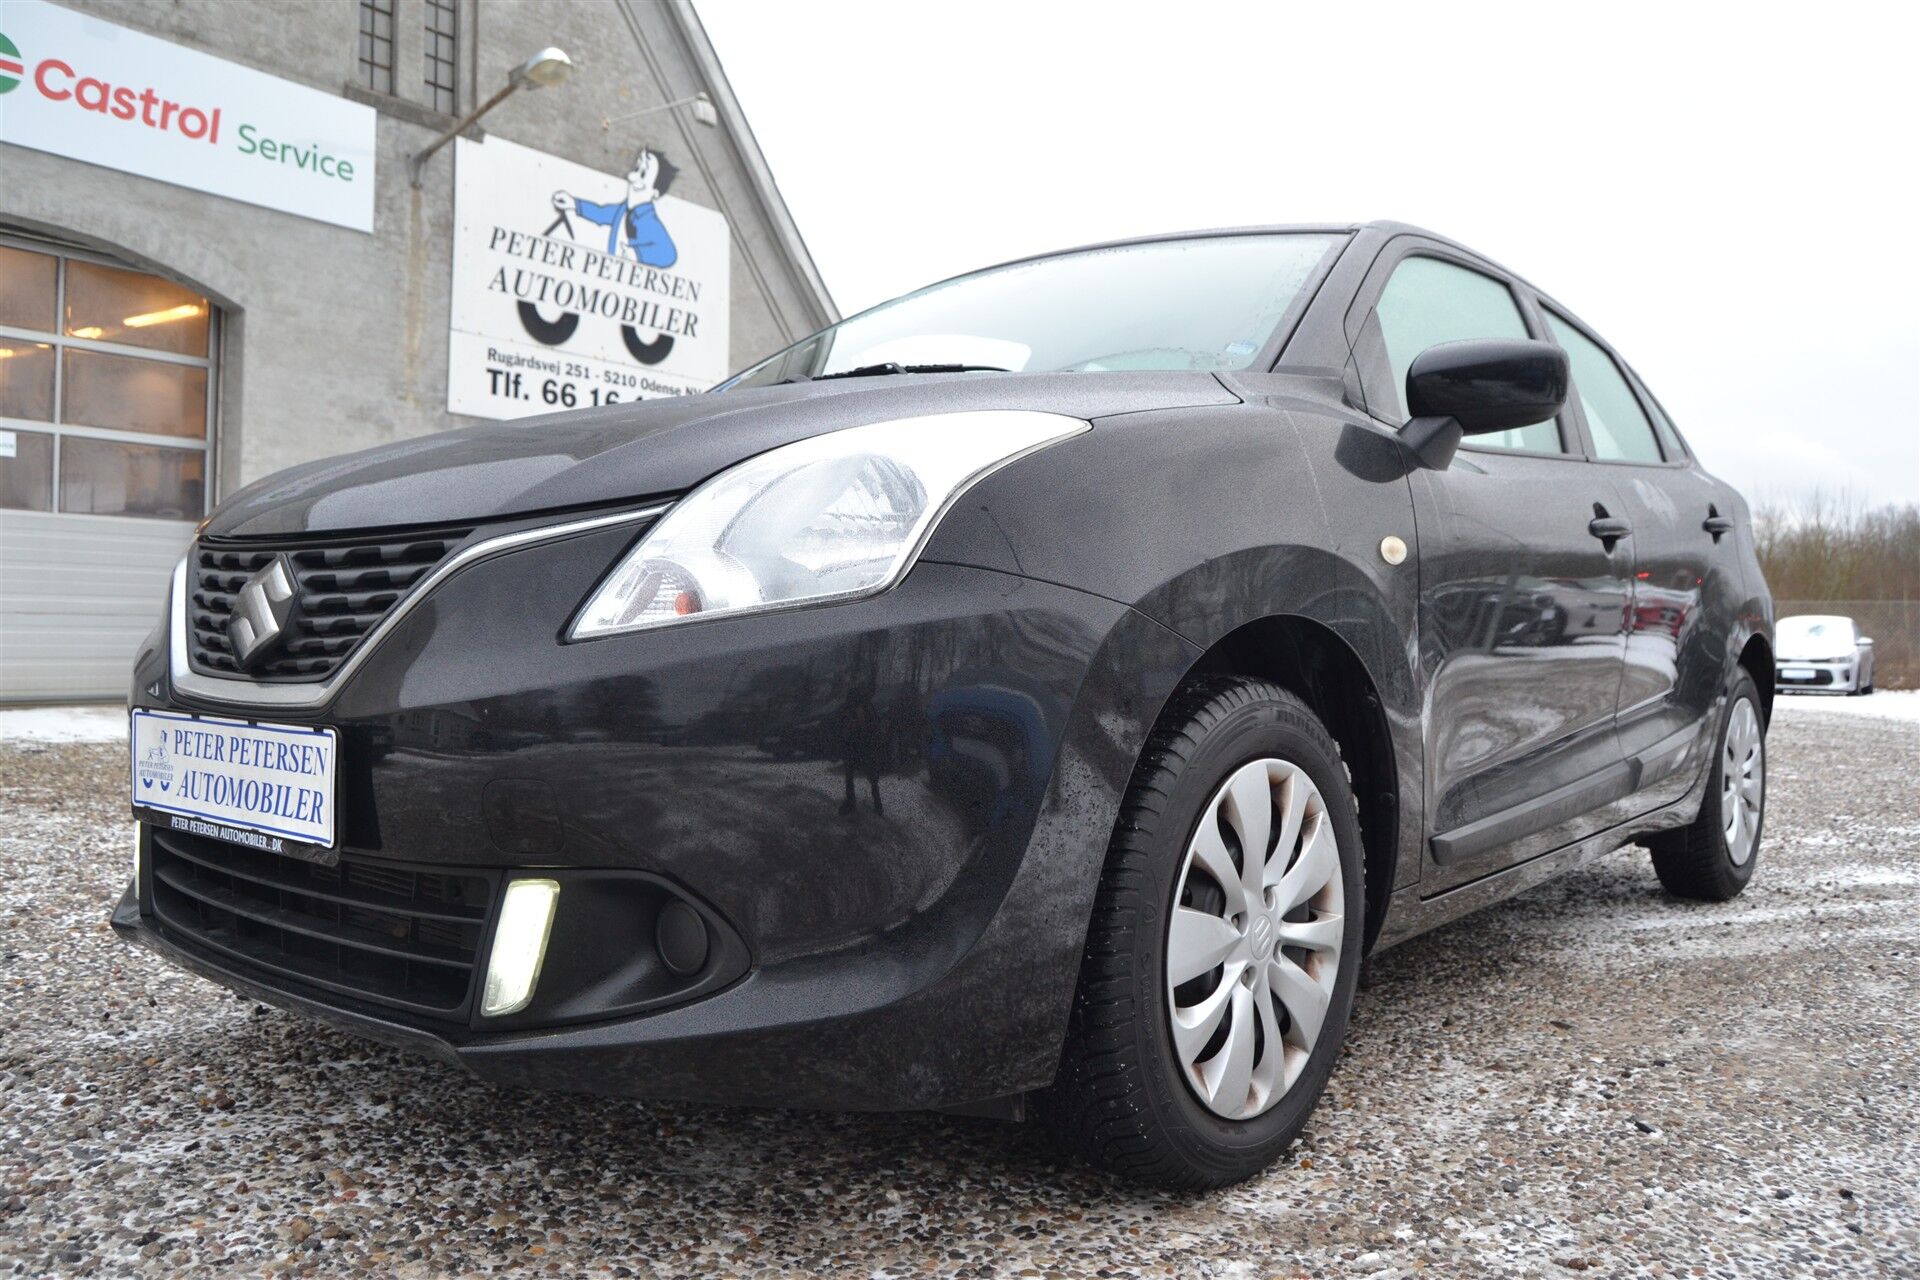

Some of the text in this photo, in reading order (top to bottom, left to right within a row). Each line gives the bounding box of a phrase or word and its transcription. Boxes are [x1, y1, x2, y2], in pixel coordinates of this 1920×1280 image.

[34, 58, 355, 182] Castrol Service
[488, 226, 702, 302] PETER PETERSEN
[487, 265, 699, 338] AUTOMOBILER
[486, 366, 621, 408] Tlf. 66 16
[487, 347, 560, 376] Rugårdsvej
[565, 362, 590, 379] 251
[604, 370, 637, 388] 5210
[640, 377, 682, 395] Odense
[138, 760, 154, 769] PETER
[174, 729, 328, 776] PETER PETERSEN
[176, 769, 324, 825] AUTOMOBILER
[171, 816, 189, 830] PETER
[189, 820, 220, 837] PETERSEN
